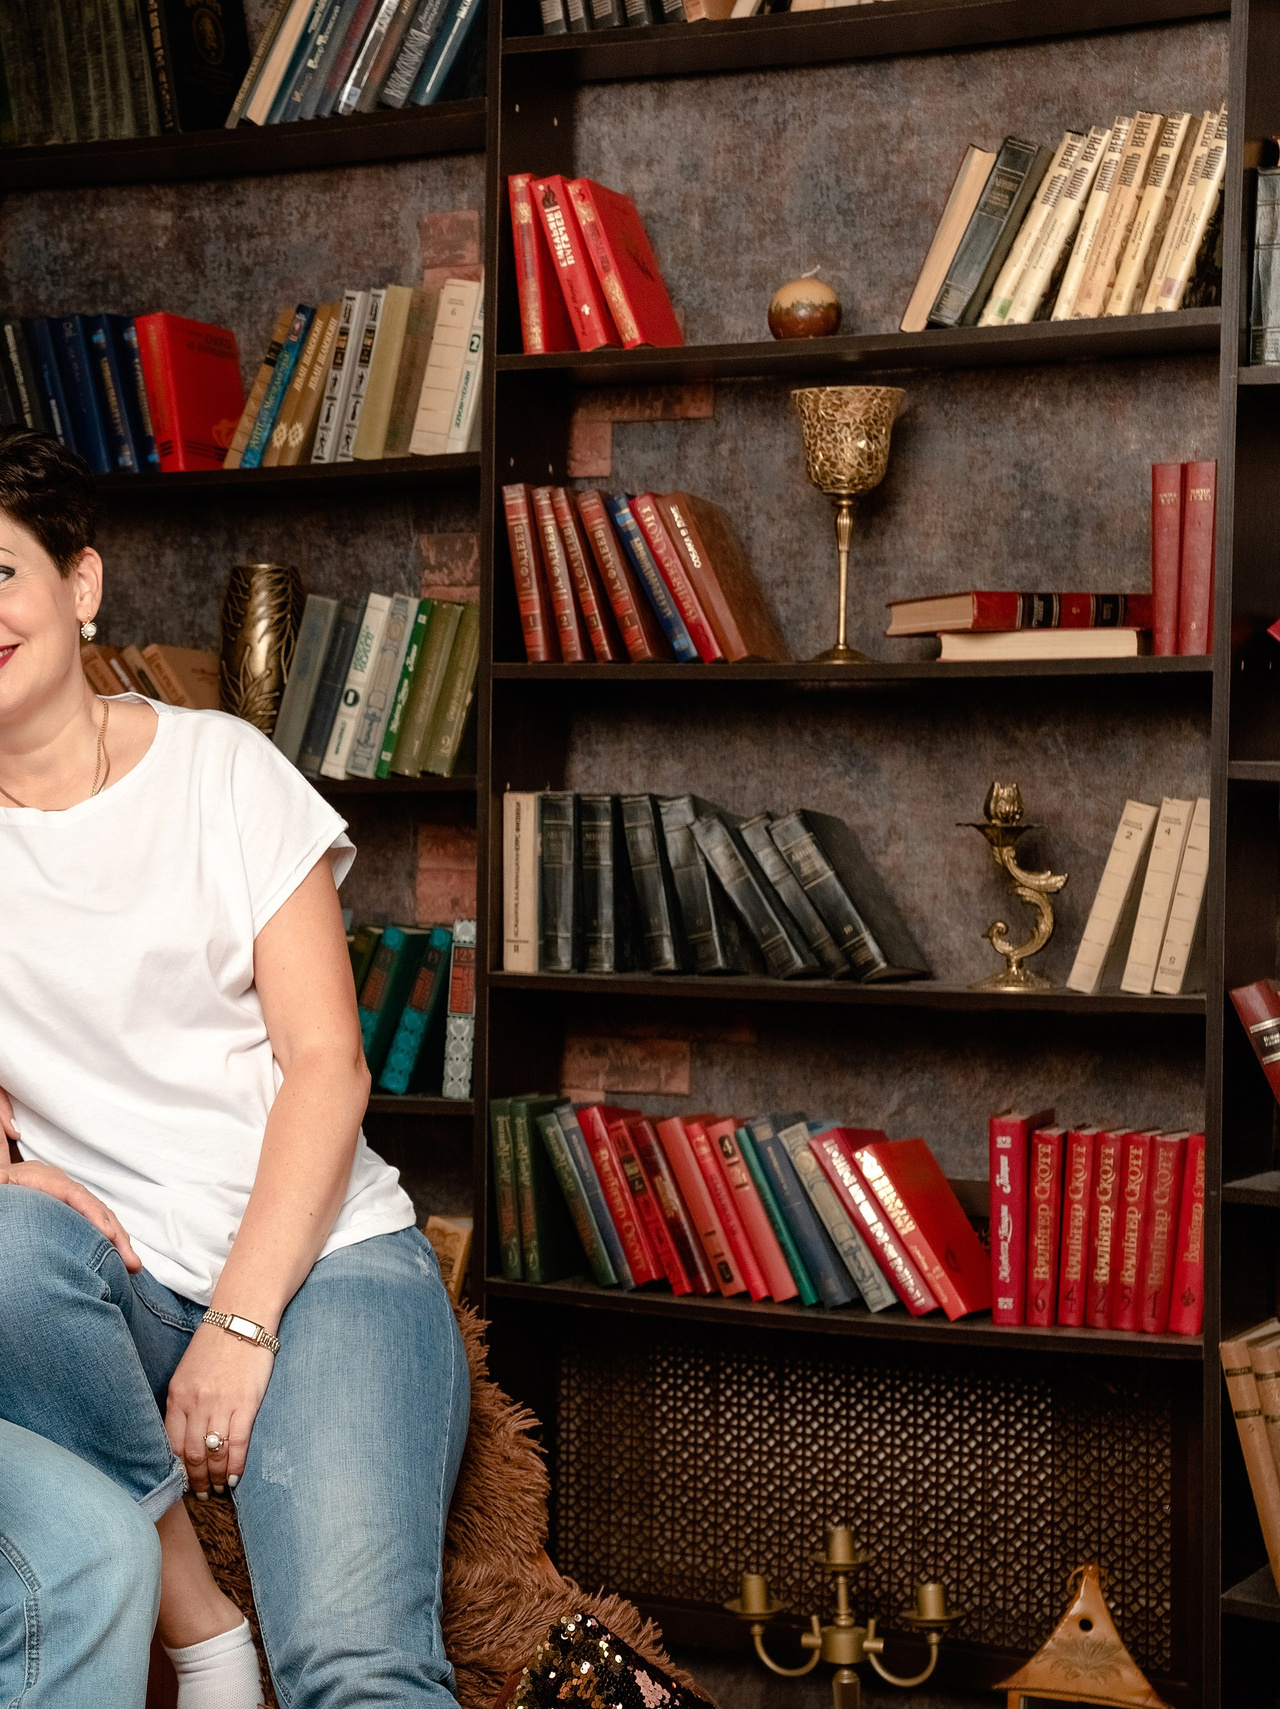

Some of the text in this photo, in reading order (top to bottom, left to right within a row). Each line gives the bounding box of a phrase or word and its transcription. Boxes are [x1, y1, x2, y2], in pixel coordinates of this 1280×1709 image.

[1042, 174, 1067, 208] ЖЮЛЬ
[1059, 143, 1079, 170] ВЕРН
[1064, 166, 1089, 200] ЖЮЛЬ
[1081, 136, 1102, 162] ВЕРН
[1096, 159, 1119, 192] ЖЮЛЬ
[1108, 127, 1128, 153] ВЕРН
[1118, 153, 1141, 187] ЖЮЛЬ
[1131, 121, 1151, 147] ВЕРН
[1148, 121, 1181, 187] ЖЮЛЬ ВЕРН
[1201, 146, 1224, 180] ЖЮЛЬ
[545, 212, 568, 268] ЕМЕЛЬЯН
[555, 209, 576, 266] ПУГАЧЕВ
[293, 317, 324, 391] ИВАН ШАМЯКИН
[308, 317, 338, 391] ИВАН ШАМЯКИН
[513, 524, 531, 577] ФАДЕЕВ
[544, 525, 561, 577] ФАДЕЕВ
[562, 525, 583, 577] ФАДЕЕВ
[594, 529, 617, 579] ФАДЕЕВ
[1124, 831, 1133, 840] 2
[872, 1179, 910, 1237] ЕМЕЛЬЯН
[1034, 1289, 1046, 1313] 6
[1064, 1286, 1077, 1313] 4
[1095, 1288, 1108, 1314] 2
